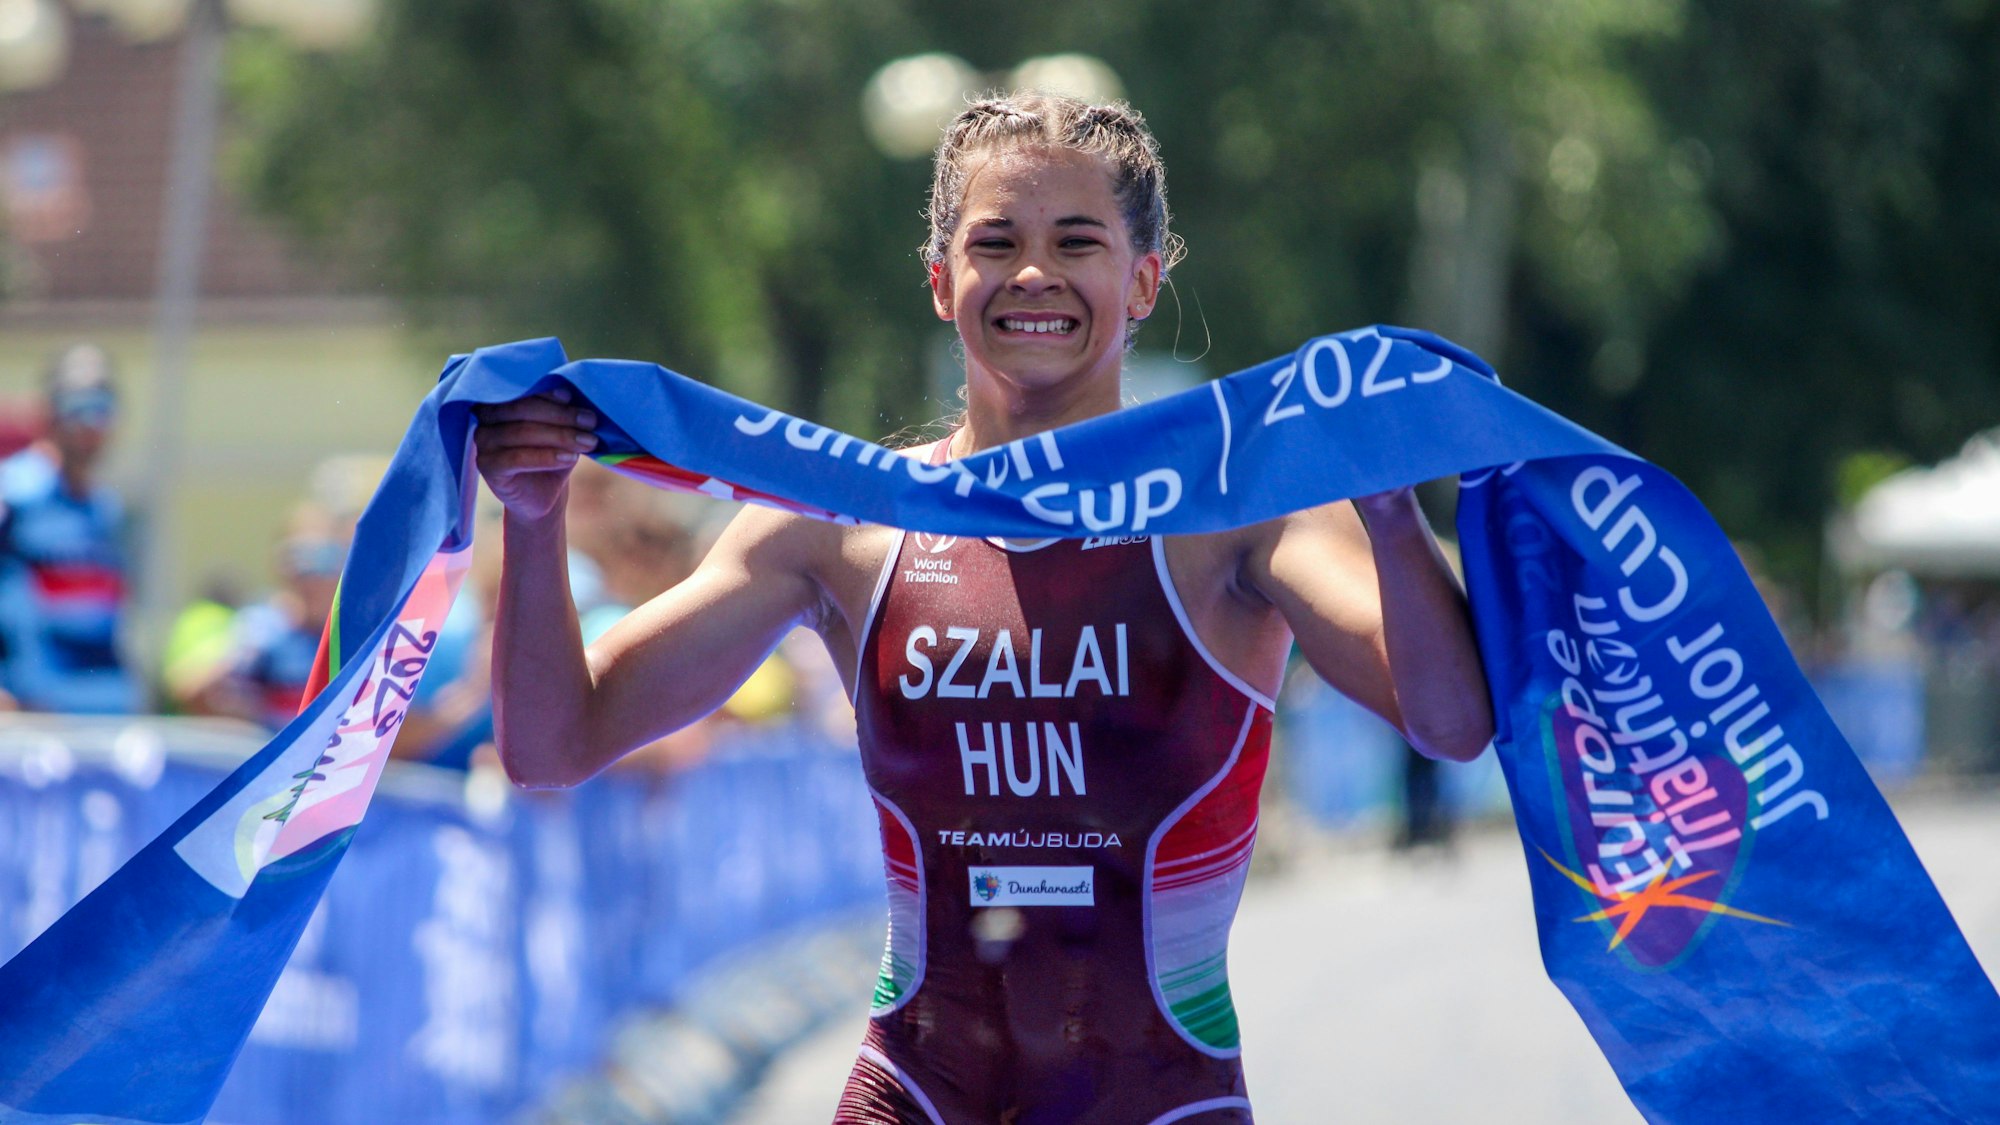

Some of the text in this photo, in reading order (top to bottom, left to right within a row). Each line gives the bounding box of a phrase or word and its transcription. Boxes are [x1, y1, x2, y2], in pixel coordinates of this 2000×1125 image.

[1021, 468, 1183, 532] Cup
[904, 570, 958, 585] Triathlon
[914, 557, 951, 571] World
[898, 623, 1130, 700] SZALAI
[1571, 465, 1829, 831] Junior Cup
[955, 722, 1087, 797] HUN
[1547, 628, 1667, 901] Europe
[1573, 593, 1742, 869] Triathlon
[1007, 879, 1092, 896] Dunaharaszti
